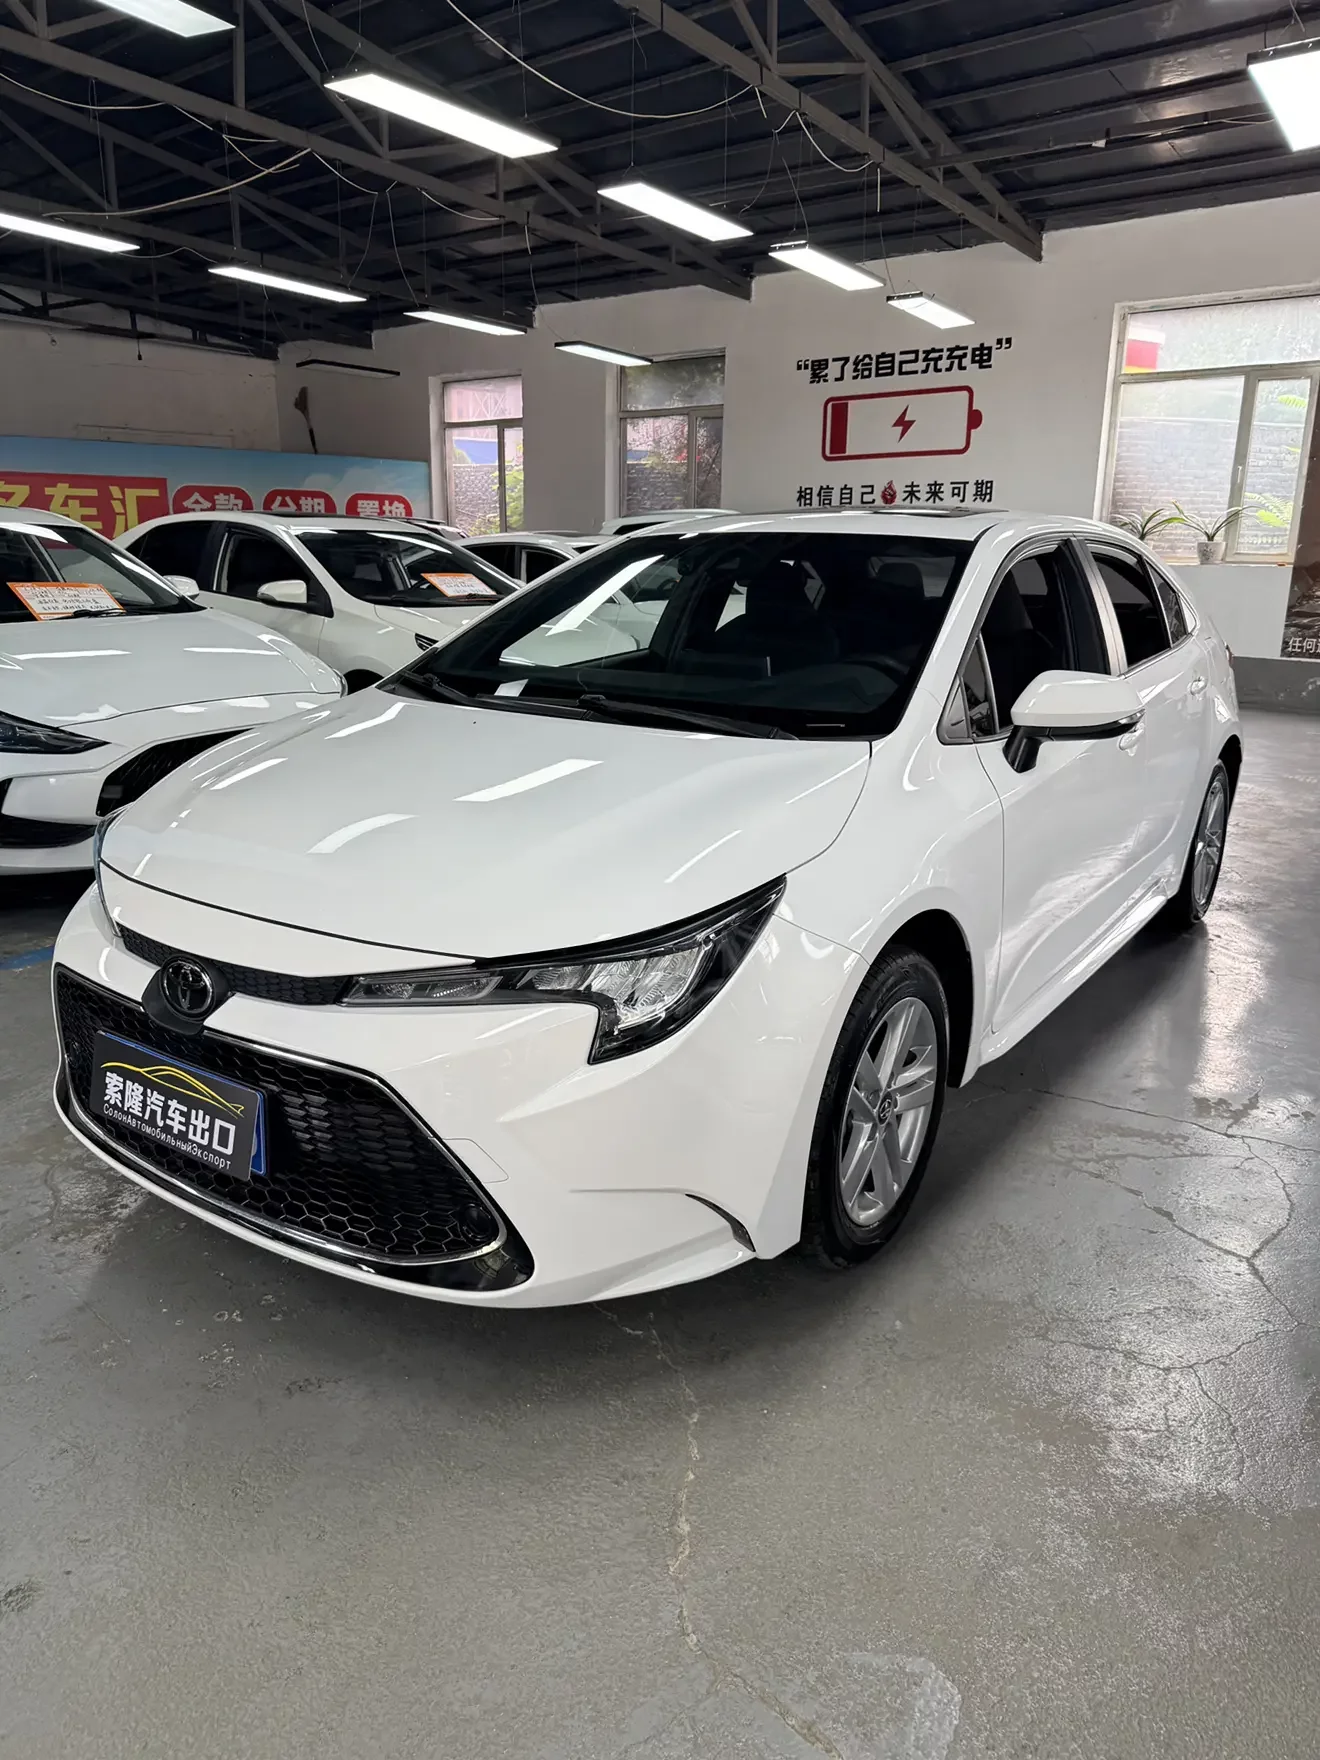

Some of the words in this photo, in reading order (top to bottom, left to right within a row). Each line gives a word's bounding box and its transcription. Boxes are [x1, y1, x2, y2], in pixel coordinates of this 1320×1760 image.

[797, 484, 876, 507] 相信自己
[903, 480, 994, 505] 未来可期
[104, 1071, 236, 1156] 索隆汽车出口
